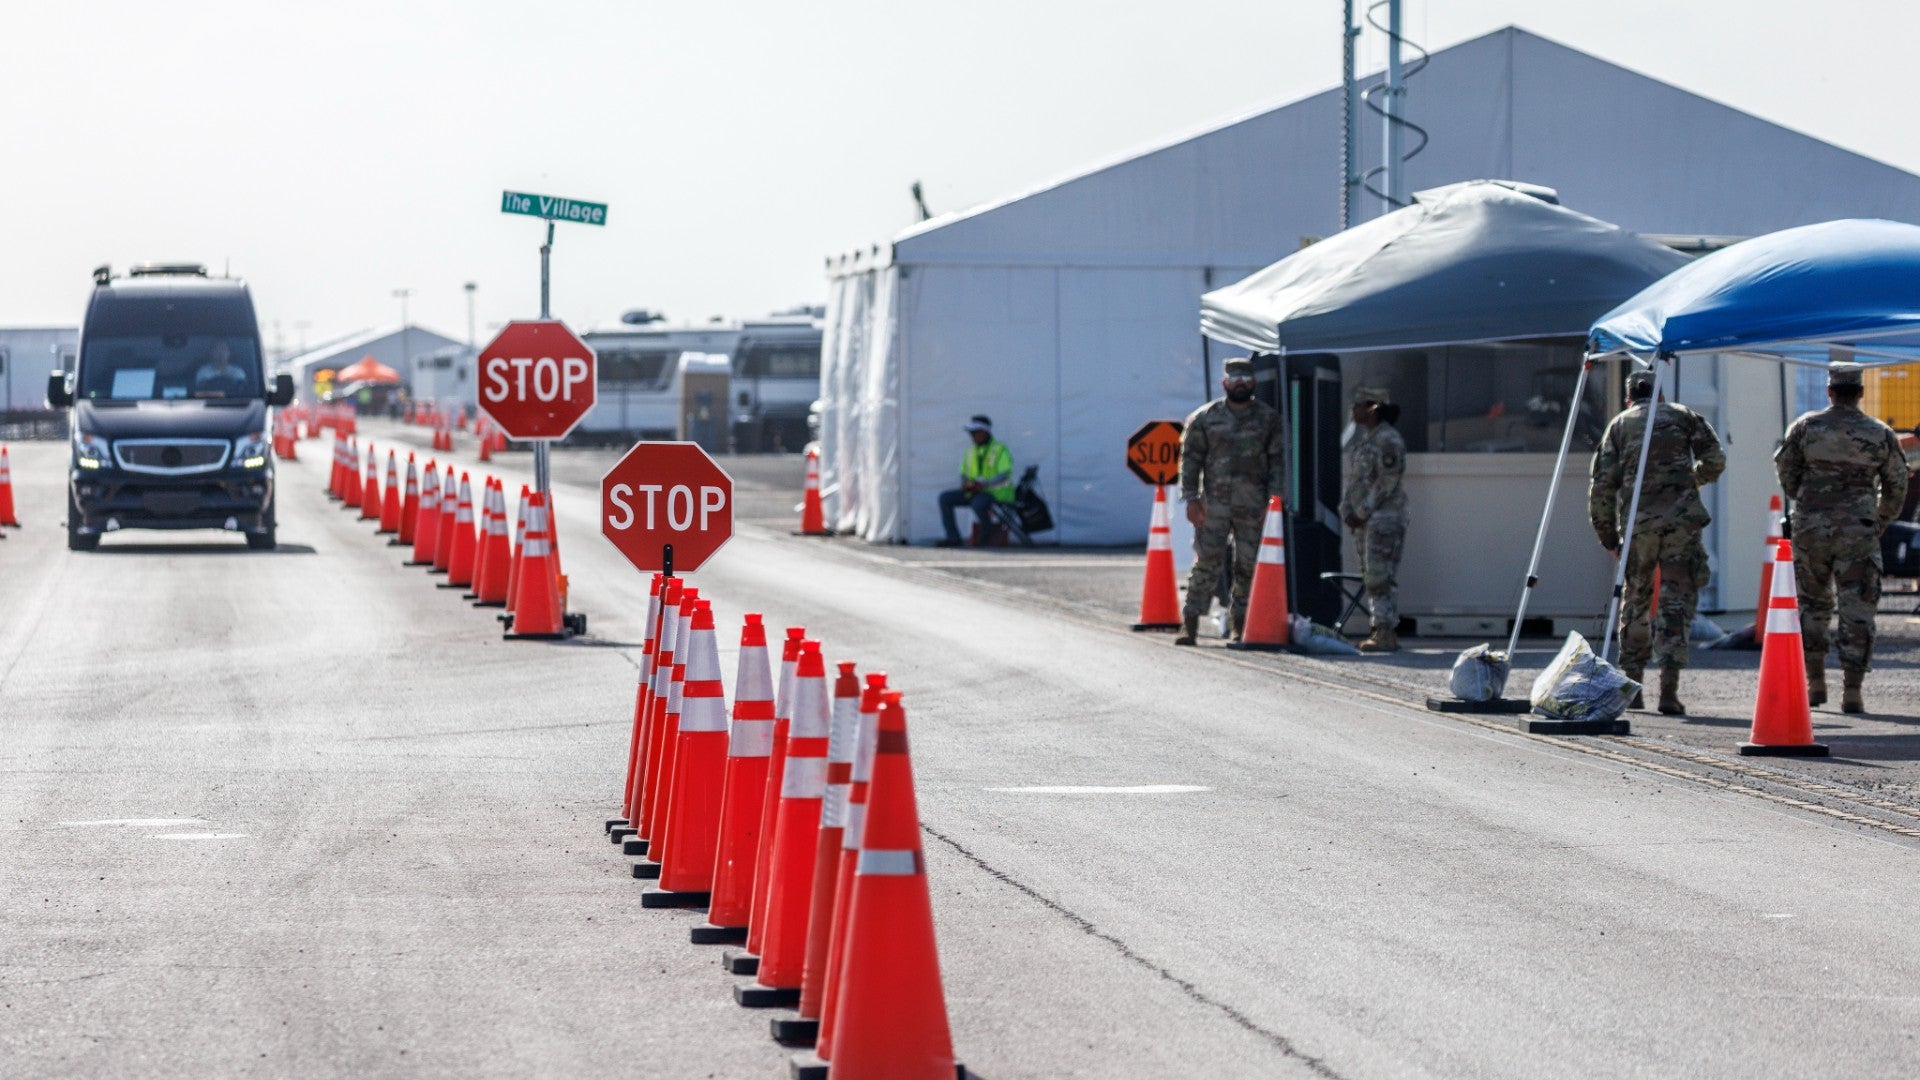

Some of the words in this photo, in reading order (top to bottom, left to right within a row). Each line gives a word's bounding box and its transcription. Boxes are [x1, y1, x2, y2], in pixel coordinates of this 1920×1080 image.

[504, 193, 531, 212] The
[539, 196, 603, 223] Village
[485, 357, 588, 402] STOP
[608, 483, 726, 532] STOP
